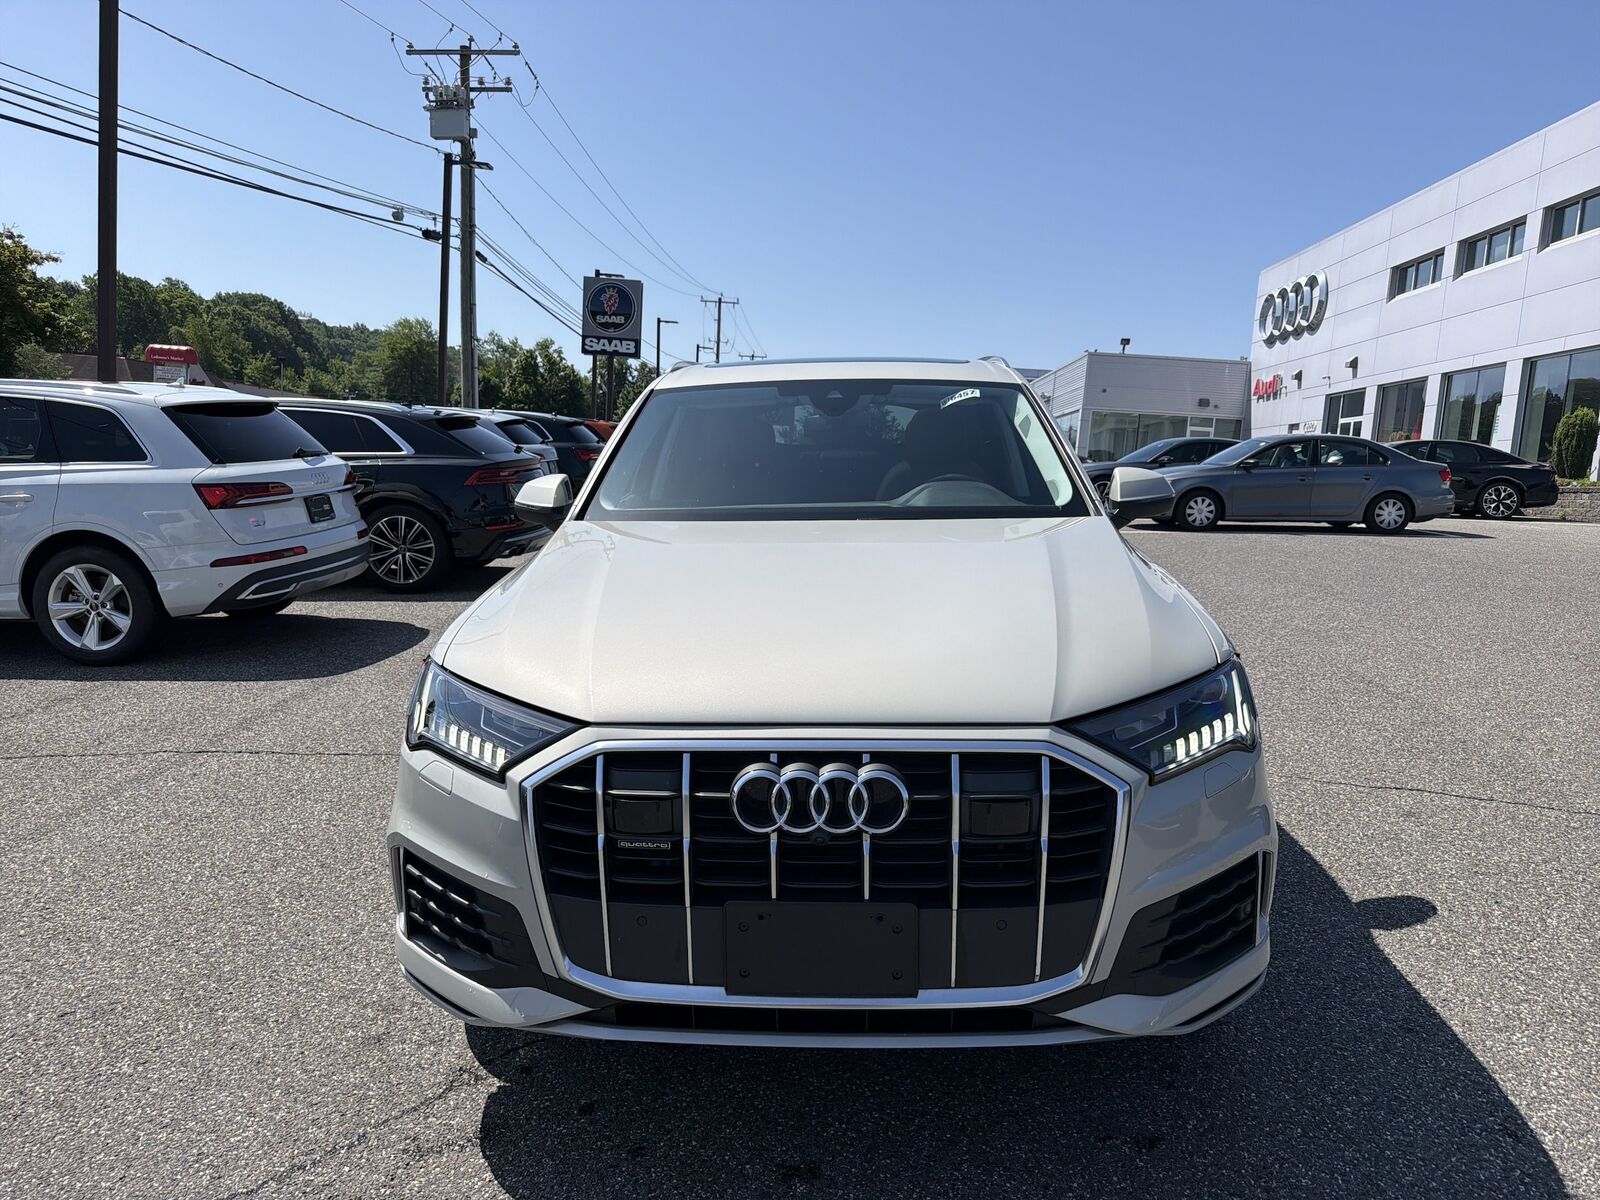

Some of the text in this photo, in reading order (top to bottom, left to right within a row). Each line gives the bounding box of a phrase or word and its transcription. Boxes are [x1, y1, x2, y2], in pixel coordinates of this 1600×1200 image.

[596, 315, 625, 324] SAAB
[584, 337, 636, 354] SAAB
[1252, 374, 1281, 397] Audi
